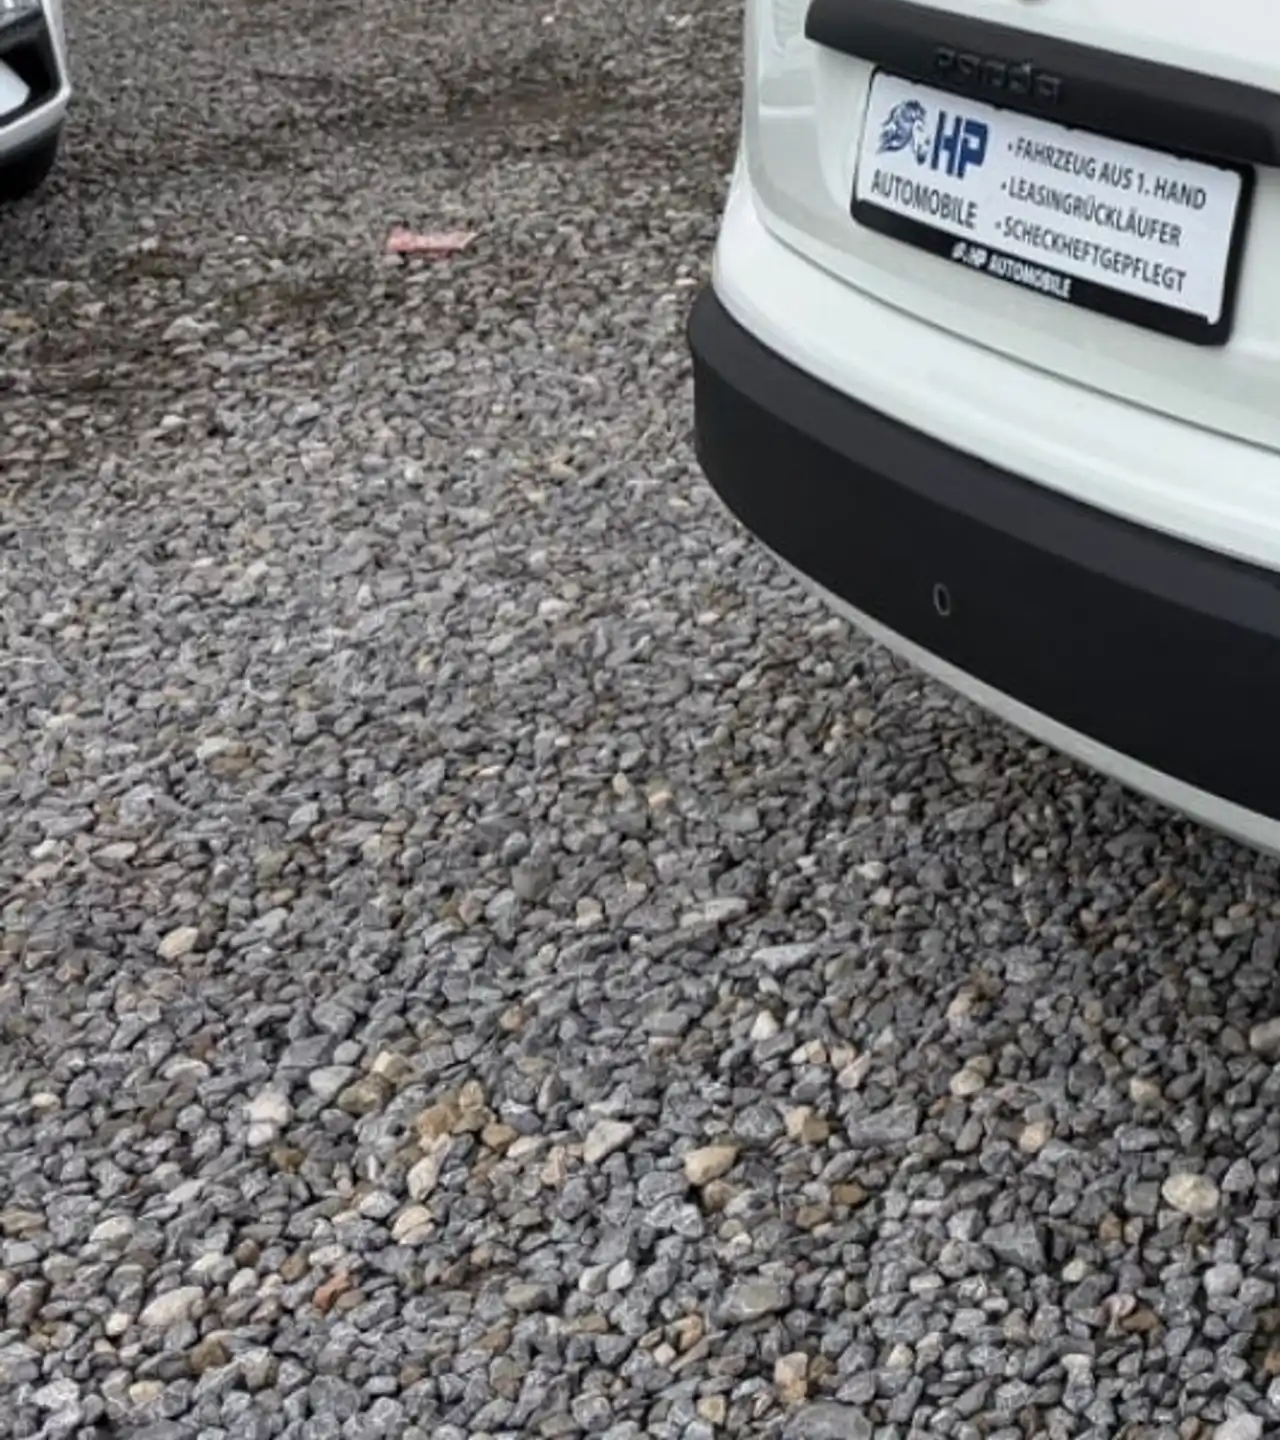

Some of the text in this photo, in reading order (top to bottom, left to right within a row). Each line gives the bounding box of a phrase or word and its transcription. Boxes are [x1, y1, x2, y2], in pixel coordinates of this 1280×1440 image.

[930, 110, 988, 180] HP
[1014, 136, 1206, 210] FAHRZEUG AUS 1. HAND
[871, 168, 977, 229] AUTOMOBILE
[1008, 176, 1182, 247] LEASINGRÜCKLÄUFER
[988, 253, 1072, 299] AUTOMOBILE
[1003, 216, 1186, 293] SCHECKHEFTGEPFLEGT
